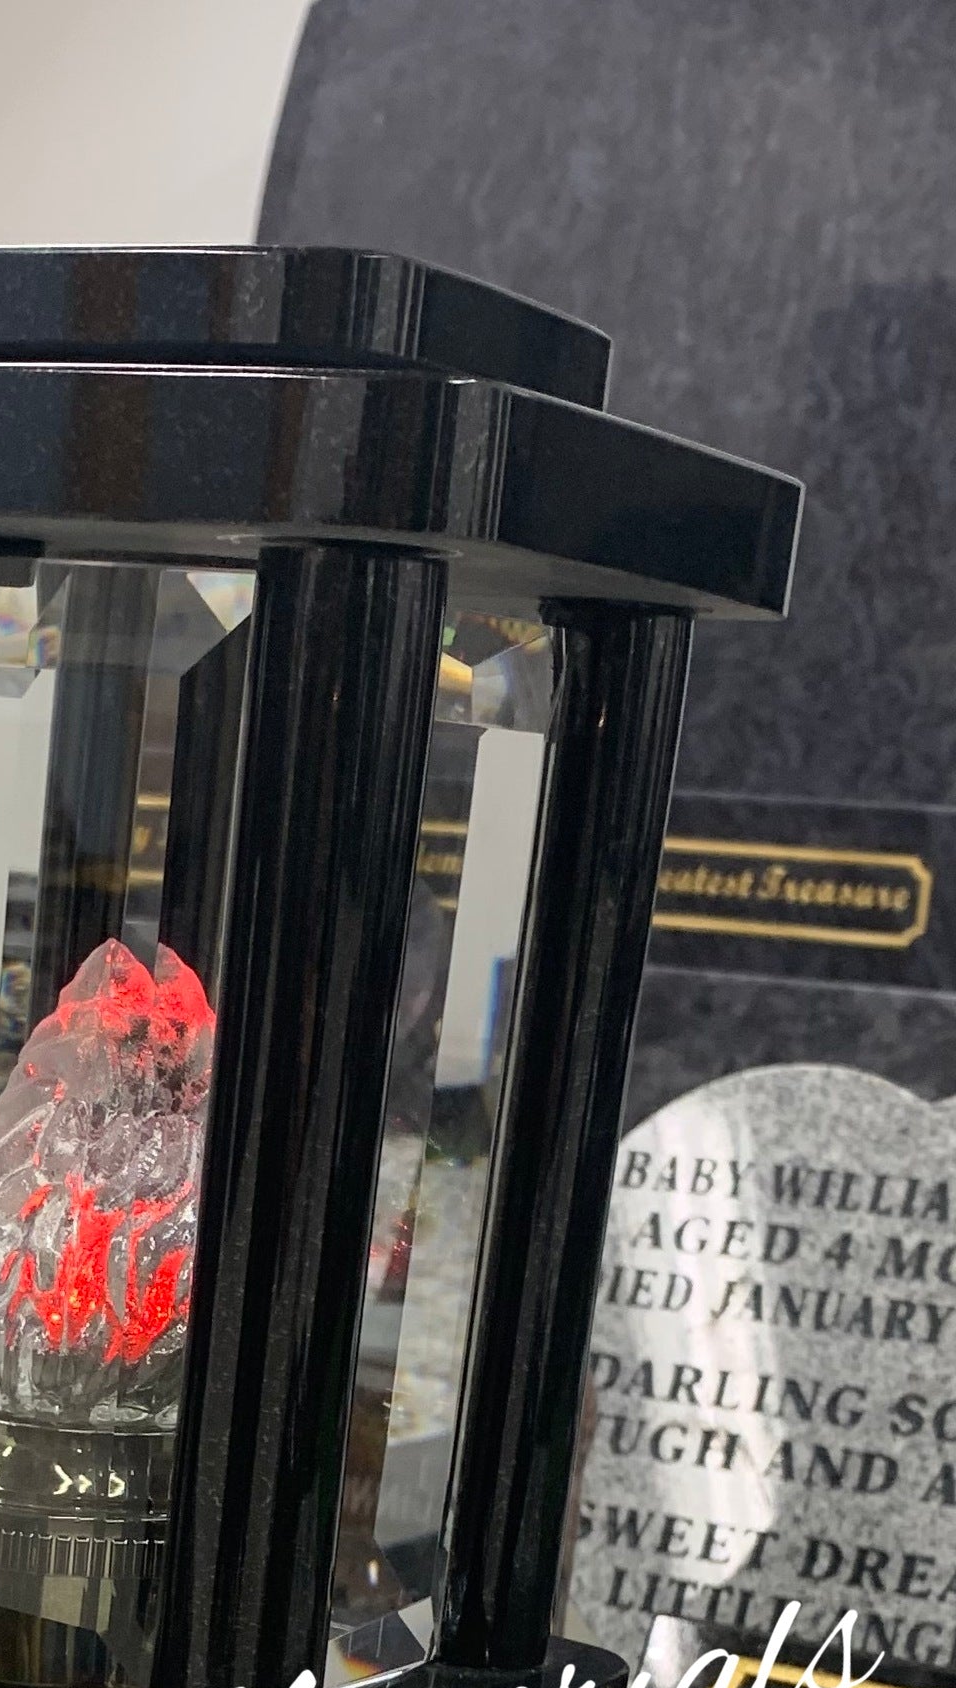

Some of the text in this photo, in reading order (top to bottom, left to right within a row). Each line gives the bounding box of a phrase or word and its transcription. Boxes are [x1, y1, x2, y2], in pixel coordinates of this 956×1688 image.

[659, 864, 754, 899] eatest
[617, 1149, 950, 1223] BABY WILLIA
[630, 1214, 800, 1266] AGED
[822, 1232, 856, 1269] 4
[597, 1264, 956, 1347] IED JANUARY
[589, 1351, 956, 1443] DARLING SO
[596, 1412, 956, 1506] UGH AND A
